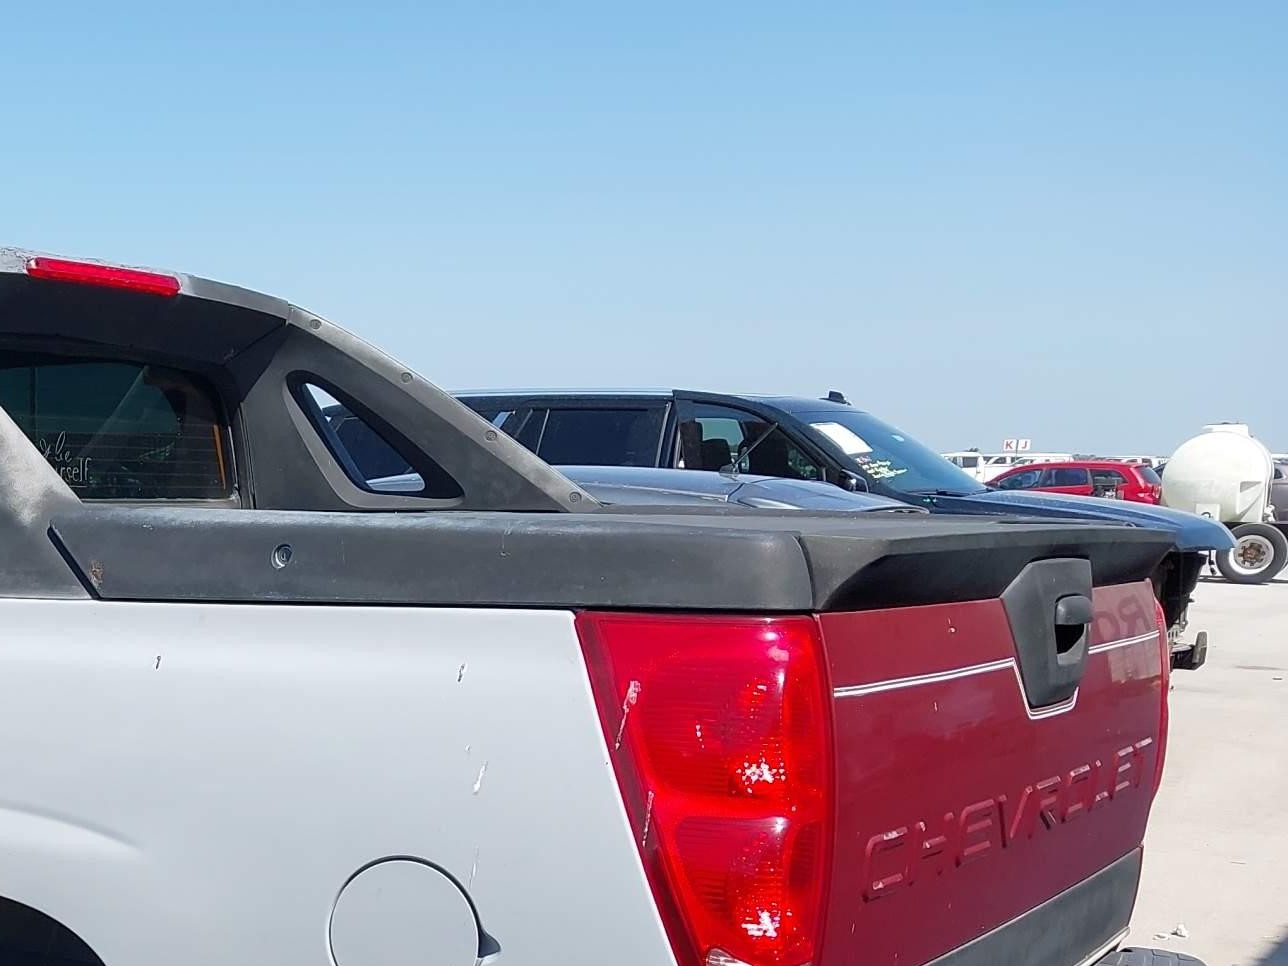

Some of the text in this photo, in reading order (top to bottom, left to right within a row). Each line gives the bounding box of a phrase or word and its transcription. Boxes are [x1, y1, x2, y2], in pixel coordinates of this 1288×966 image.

[1005, 440, 1013, 450] K
[1021, 440, 1028, 449] J
[863, 737, 1152, 903] CHEVROLET
